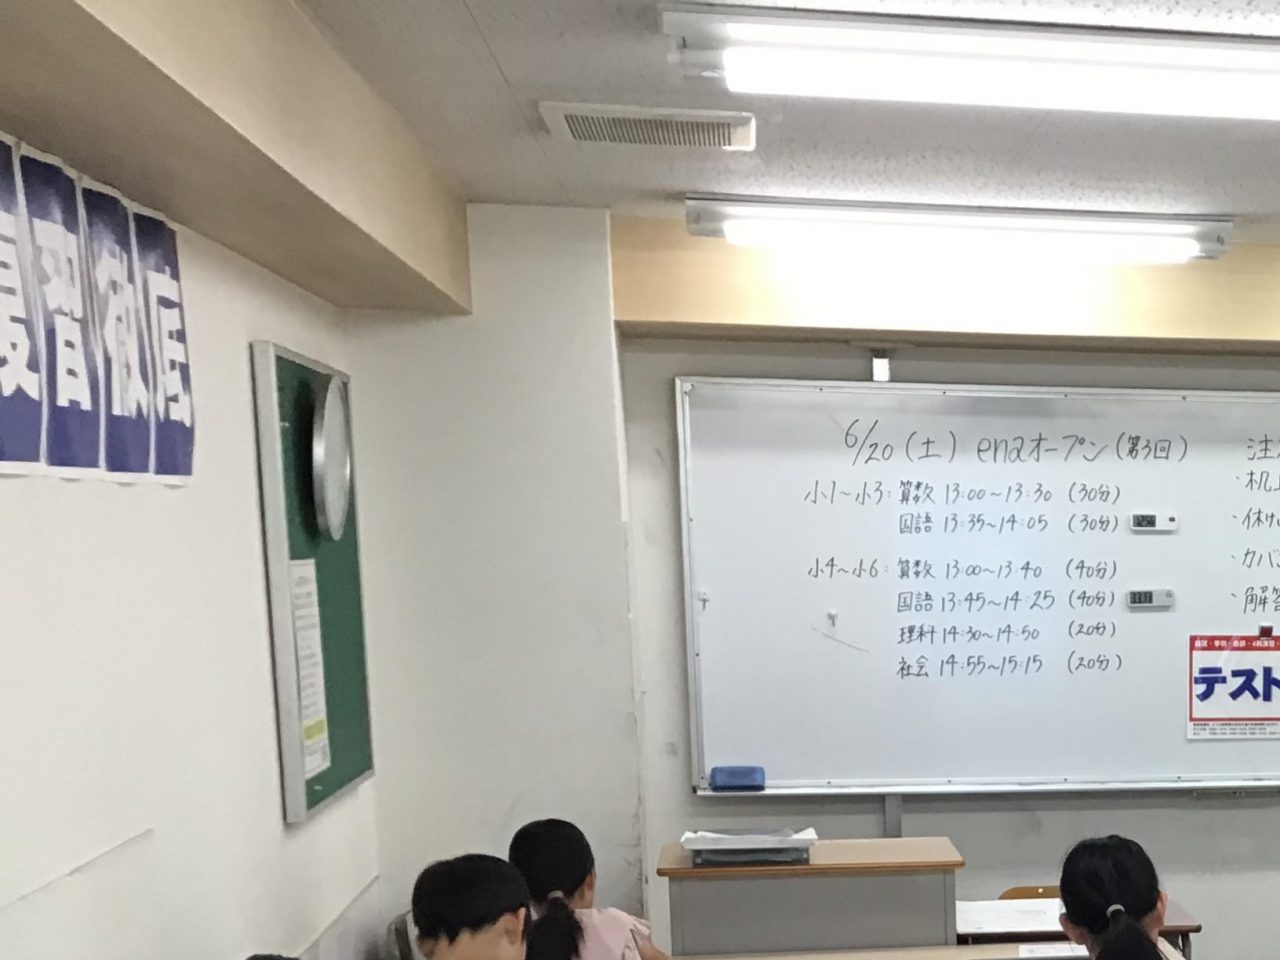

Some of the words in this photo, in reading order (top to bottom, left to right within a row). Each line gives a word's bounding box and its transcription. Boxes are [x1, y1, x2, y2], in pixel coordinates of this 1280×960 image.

[898, 480, 934, 504] 算数
[944, 482, 1053, 503] 13:00~13:30
[1067, 483, 1121, 505] (30分)
[898, 511, 933, 534] 国語
[1067, 513, 1119, 534] (30分)
[897, 558, 936, 580] 算数
[945, 559, 1043, 579] 13:00~13:40
[1065, 559, 1118, 580] (40分)
[897, 591, 934, 613] 国語
[941, 590, 1056, 612] 13:45~14:25
[1067, 589, 1116, 609] (40分)
[897, 624, 936, 645] 理科
[942, 624, 1041, 645] 14:30~14:50
[1067, 621, 1117, 639] (20分)
[896, 654, 930, 680] 社会
[939, 654, 1045, 679] 14:55~15:15
[1067, 655, 1123, 676] (20分)
